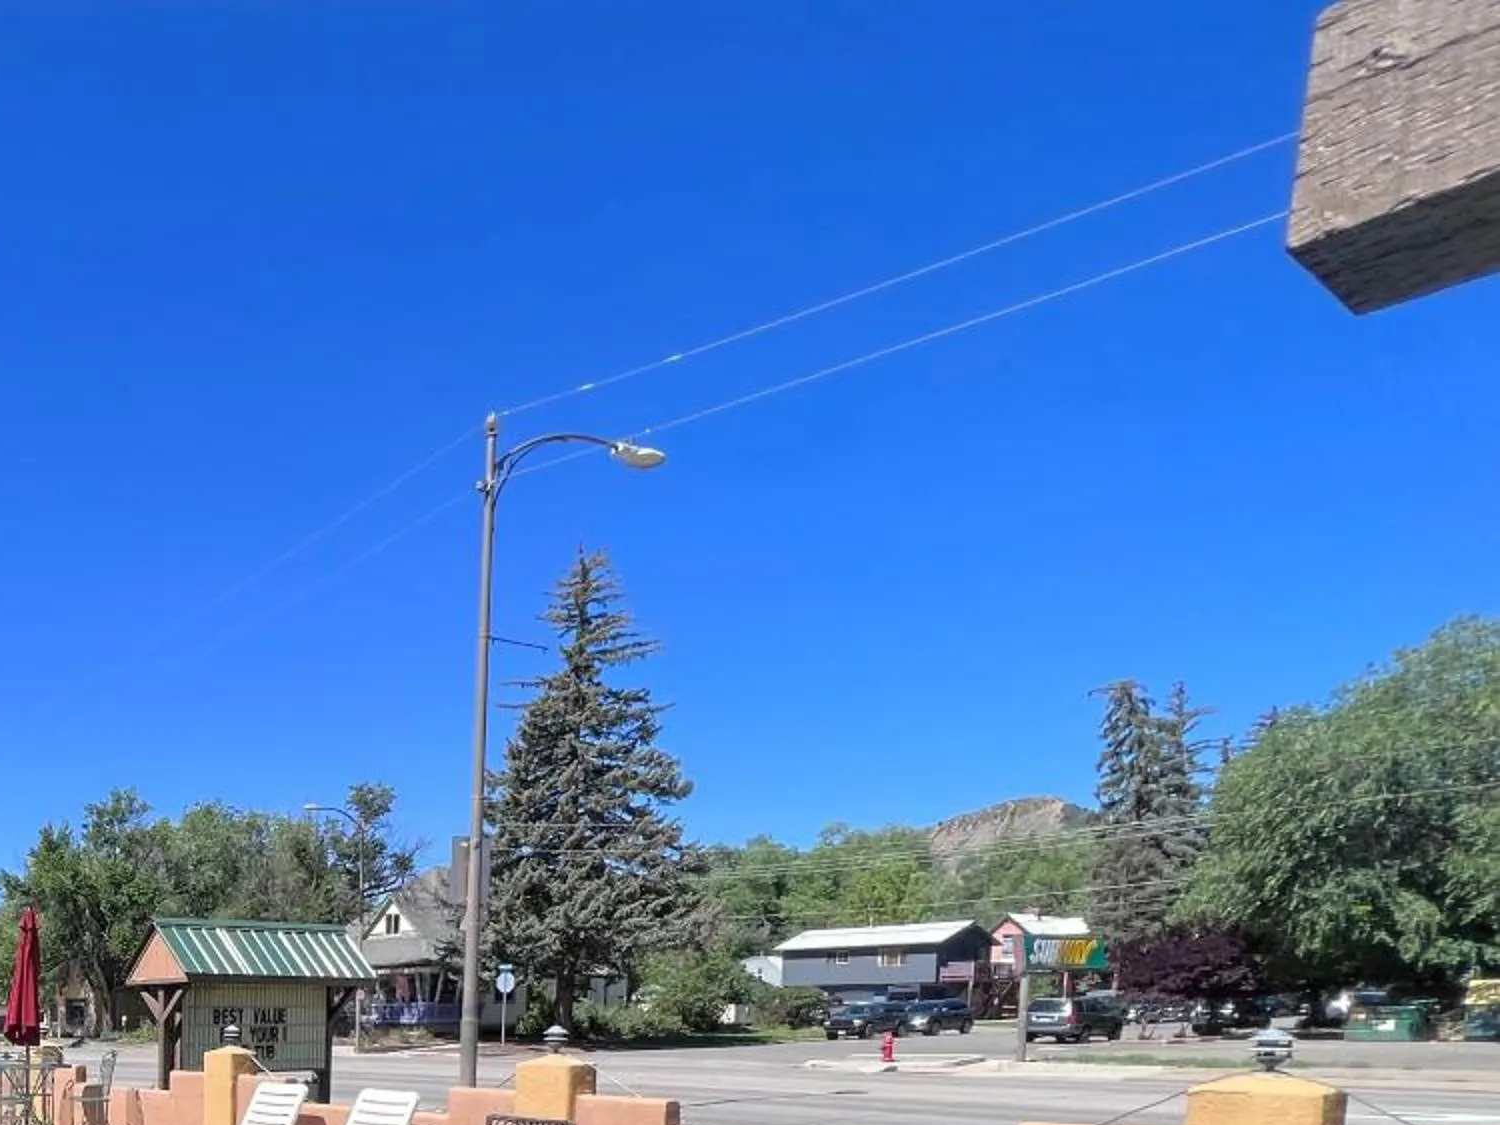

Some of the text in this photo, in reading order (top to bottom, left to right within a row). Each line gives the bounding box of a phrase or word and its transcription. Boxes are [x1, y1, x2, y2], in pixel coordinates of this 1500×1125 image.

[1028, 938, 1098, 965] SUBWAY
[213, 1007, 287, 1024] BEST VALUE
[249, 1026, 279, 1042] YOUR
